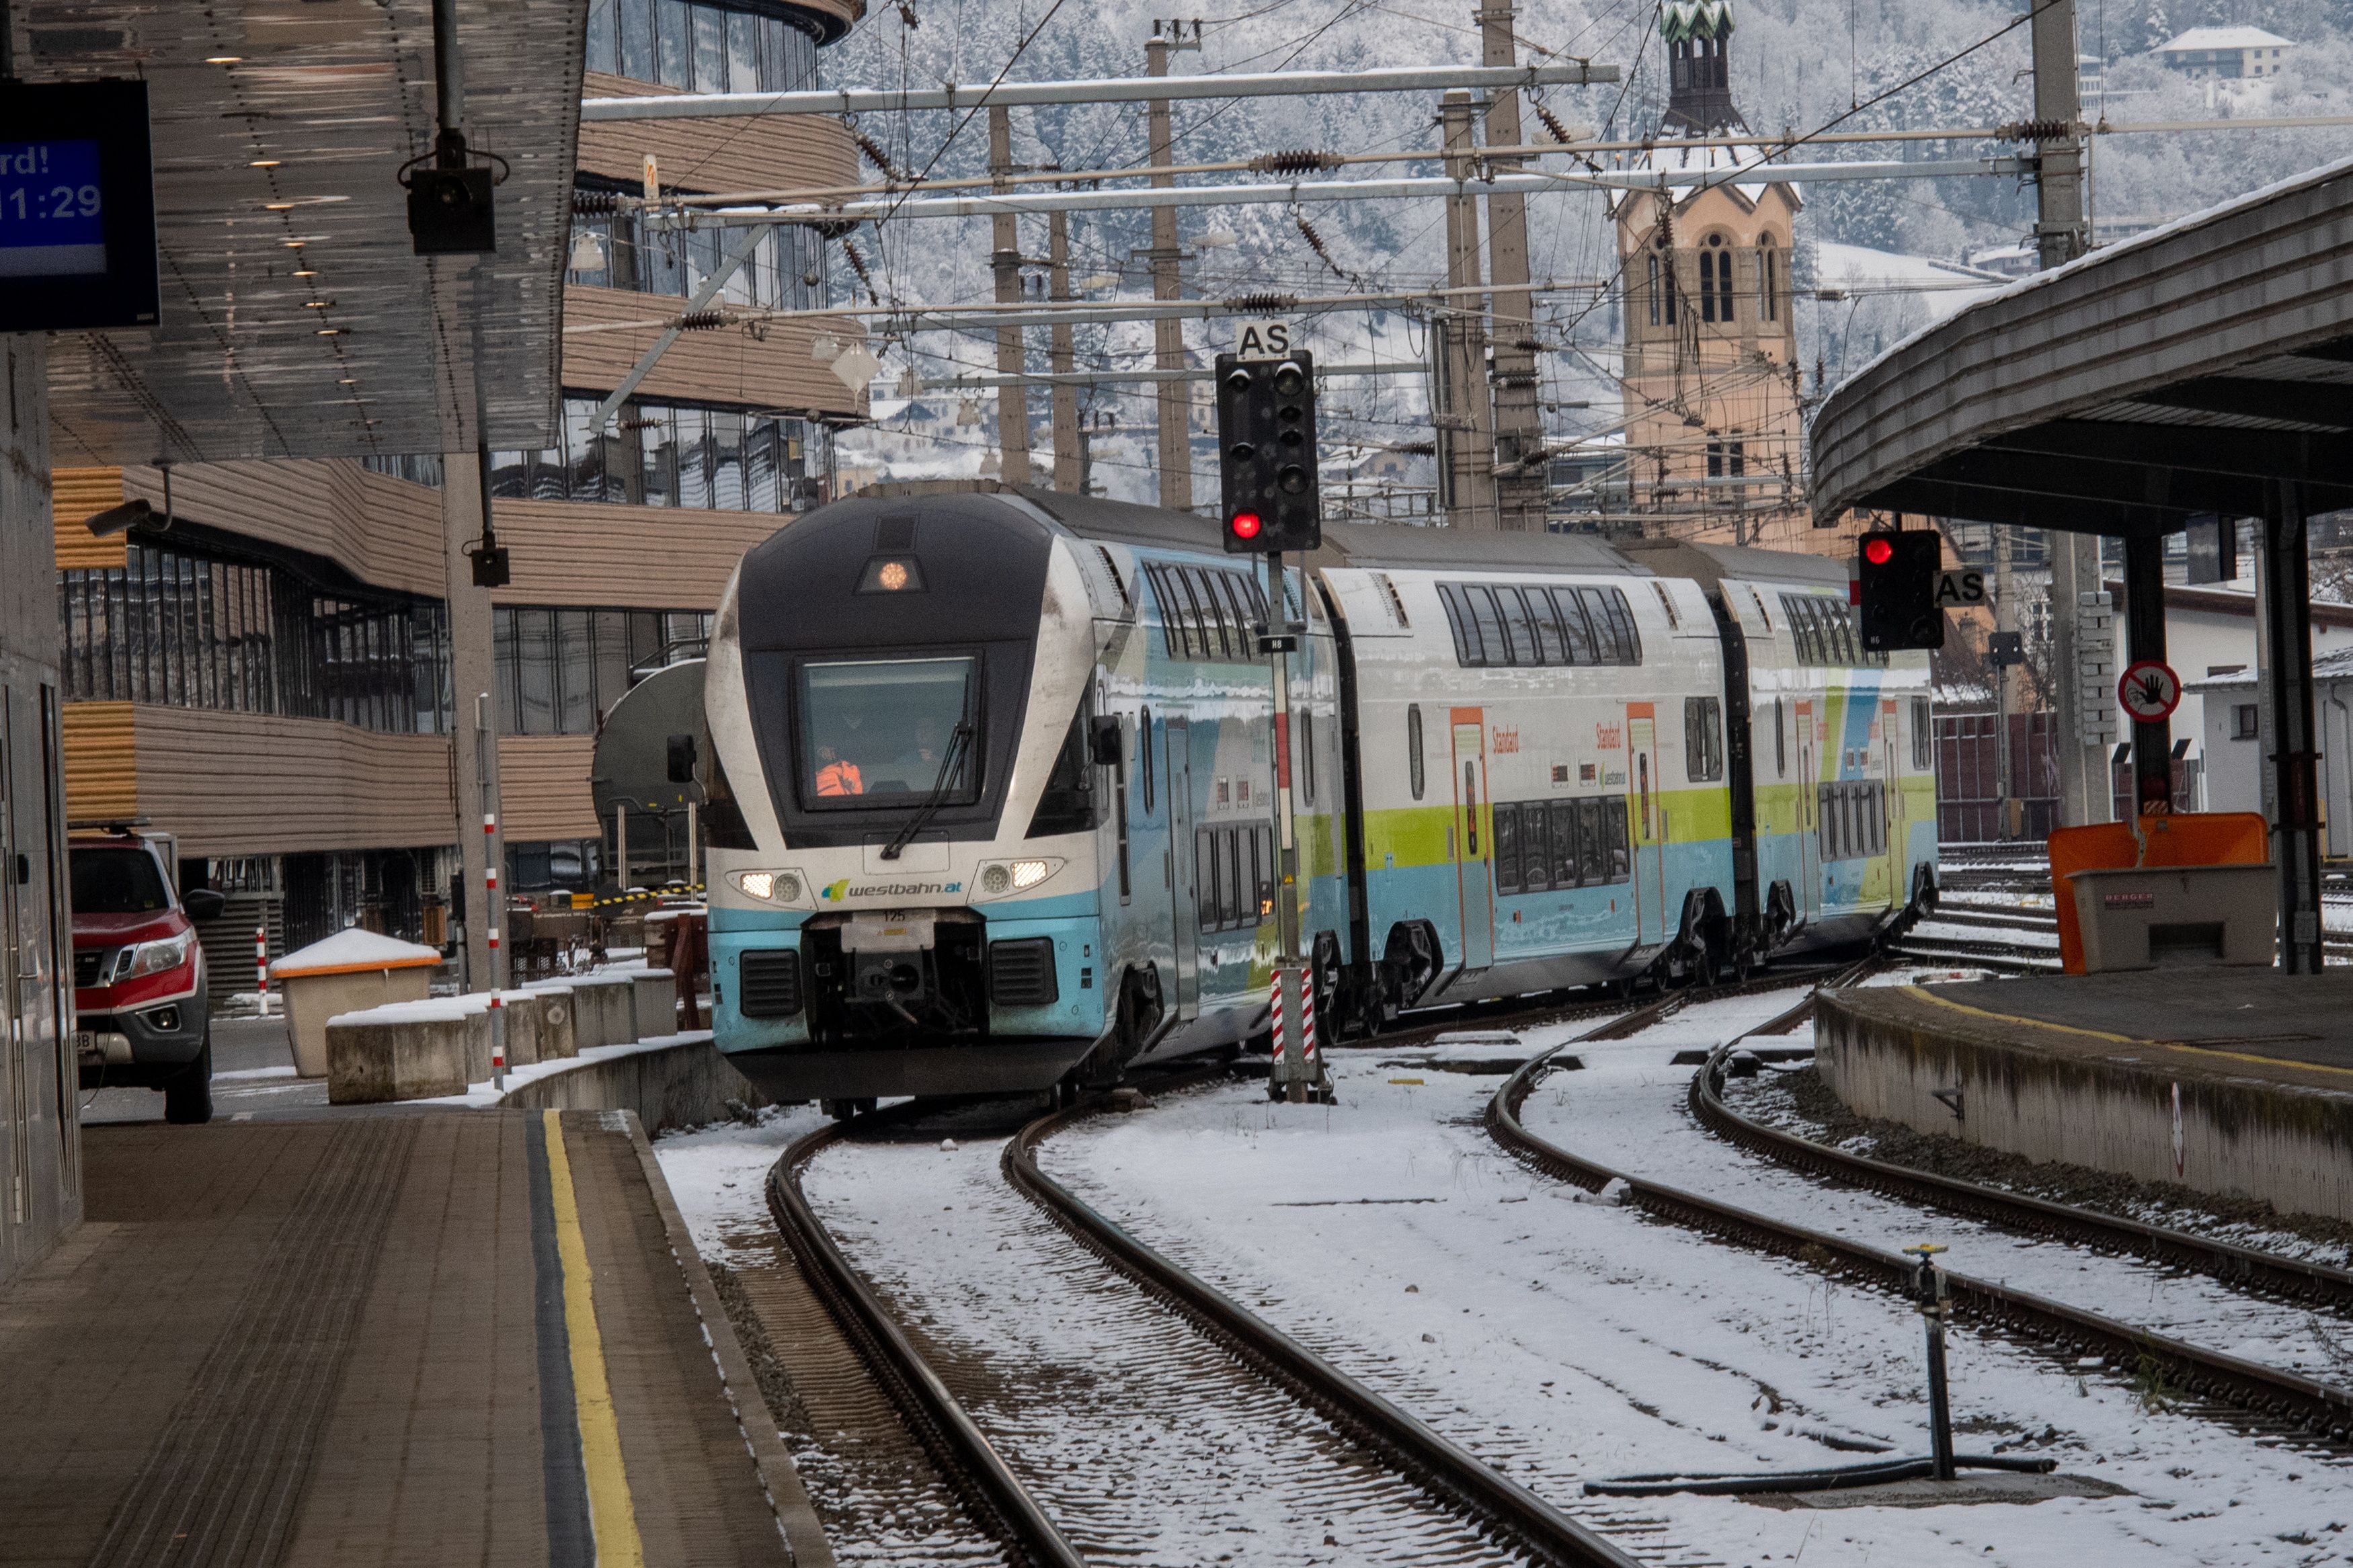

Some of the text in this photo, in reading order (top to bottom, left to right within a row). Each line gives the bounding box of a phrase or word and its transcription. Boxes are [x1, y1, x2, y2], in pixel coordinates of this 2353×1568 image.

[0, 146, 48, 175] rd!
[0, 185, 102, 220] 1:29
[1238, 325, 1289, 355] AS
[1935, 573, 1984, 602] AS
[1272, 639, 1282, 649] H8
[848, 881, 962, 897] westbahn.at
[883, 909, 906, 922] 125
